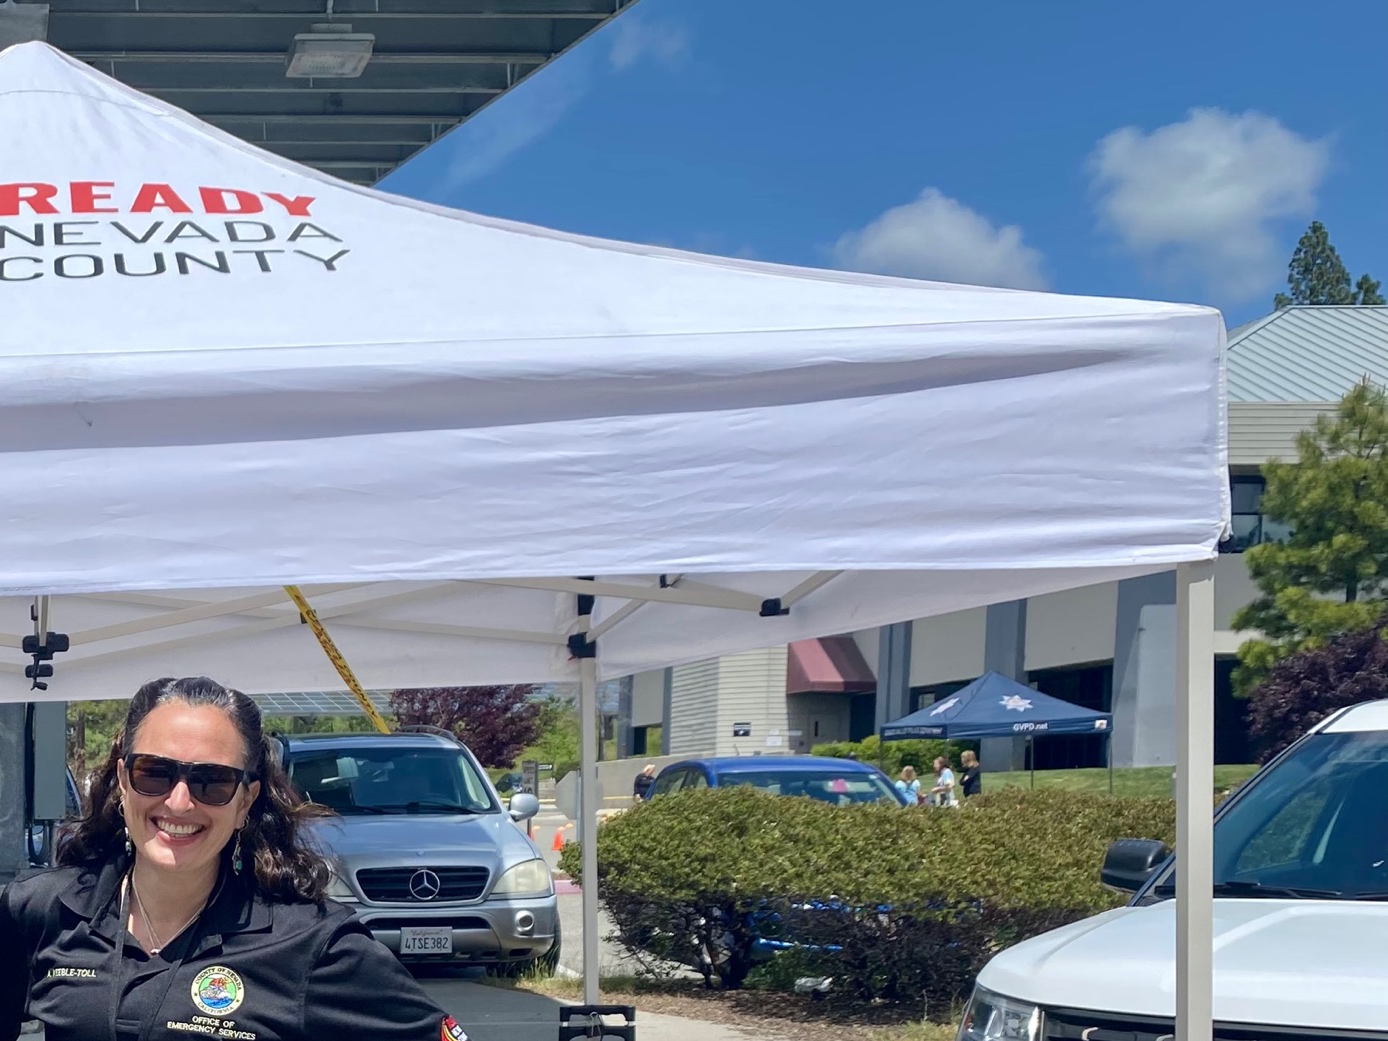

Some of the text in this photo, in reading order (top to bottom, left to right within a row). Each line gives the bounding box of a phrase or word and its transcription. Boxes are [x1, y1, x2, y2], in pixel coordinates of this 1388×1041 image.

[1013, 722, 1049, 731] GVPD.net
[405, 937, 449, 950] 4TSE382
[195, 968, 216, 985] COUNTY
[192, 1015, 235, 1029] OFFICE OF
[167, 1021, 257, 1041] EMERGENCY SERVICES
